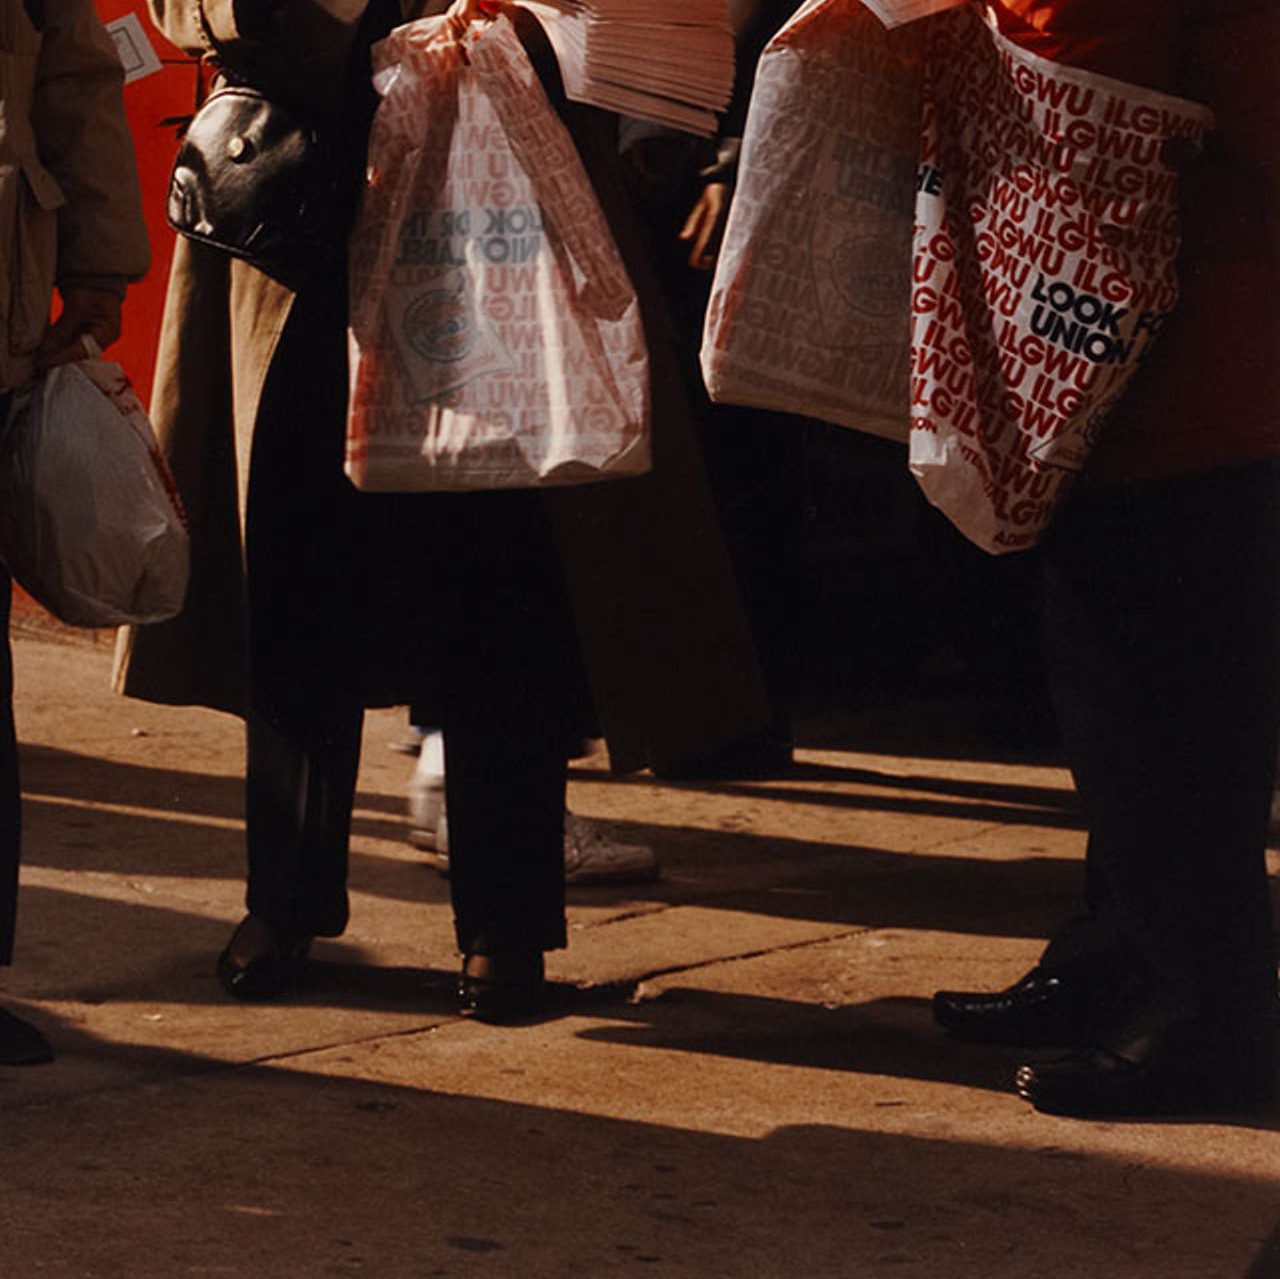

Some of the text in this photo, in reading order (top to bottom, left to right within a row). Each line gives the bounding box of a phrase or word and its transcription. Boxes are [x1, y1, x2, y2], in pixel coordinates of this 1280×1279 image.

[999, 49, 1096, 119] ILGWU
[1043, 107, 1164, 167] ILGWU
[1085, 154, 1180, 204] ILGW
[1030, 304, 1132, 365] UNION
[1031, 272, 1169, 340] LOOK FO
[997, 320, 1102, 391] ILGWU
